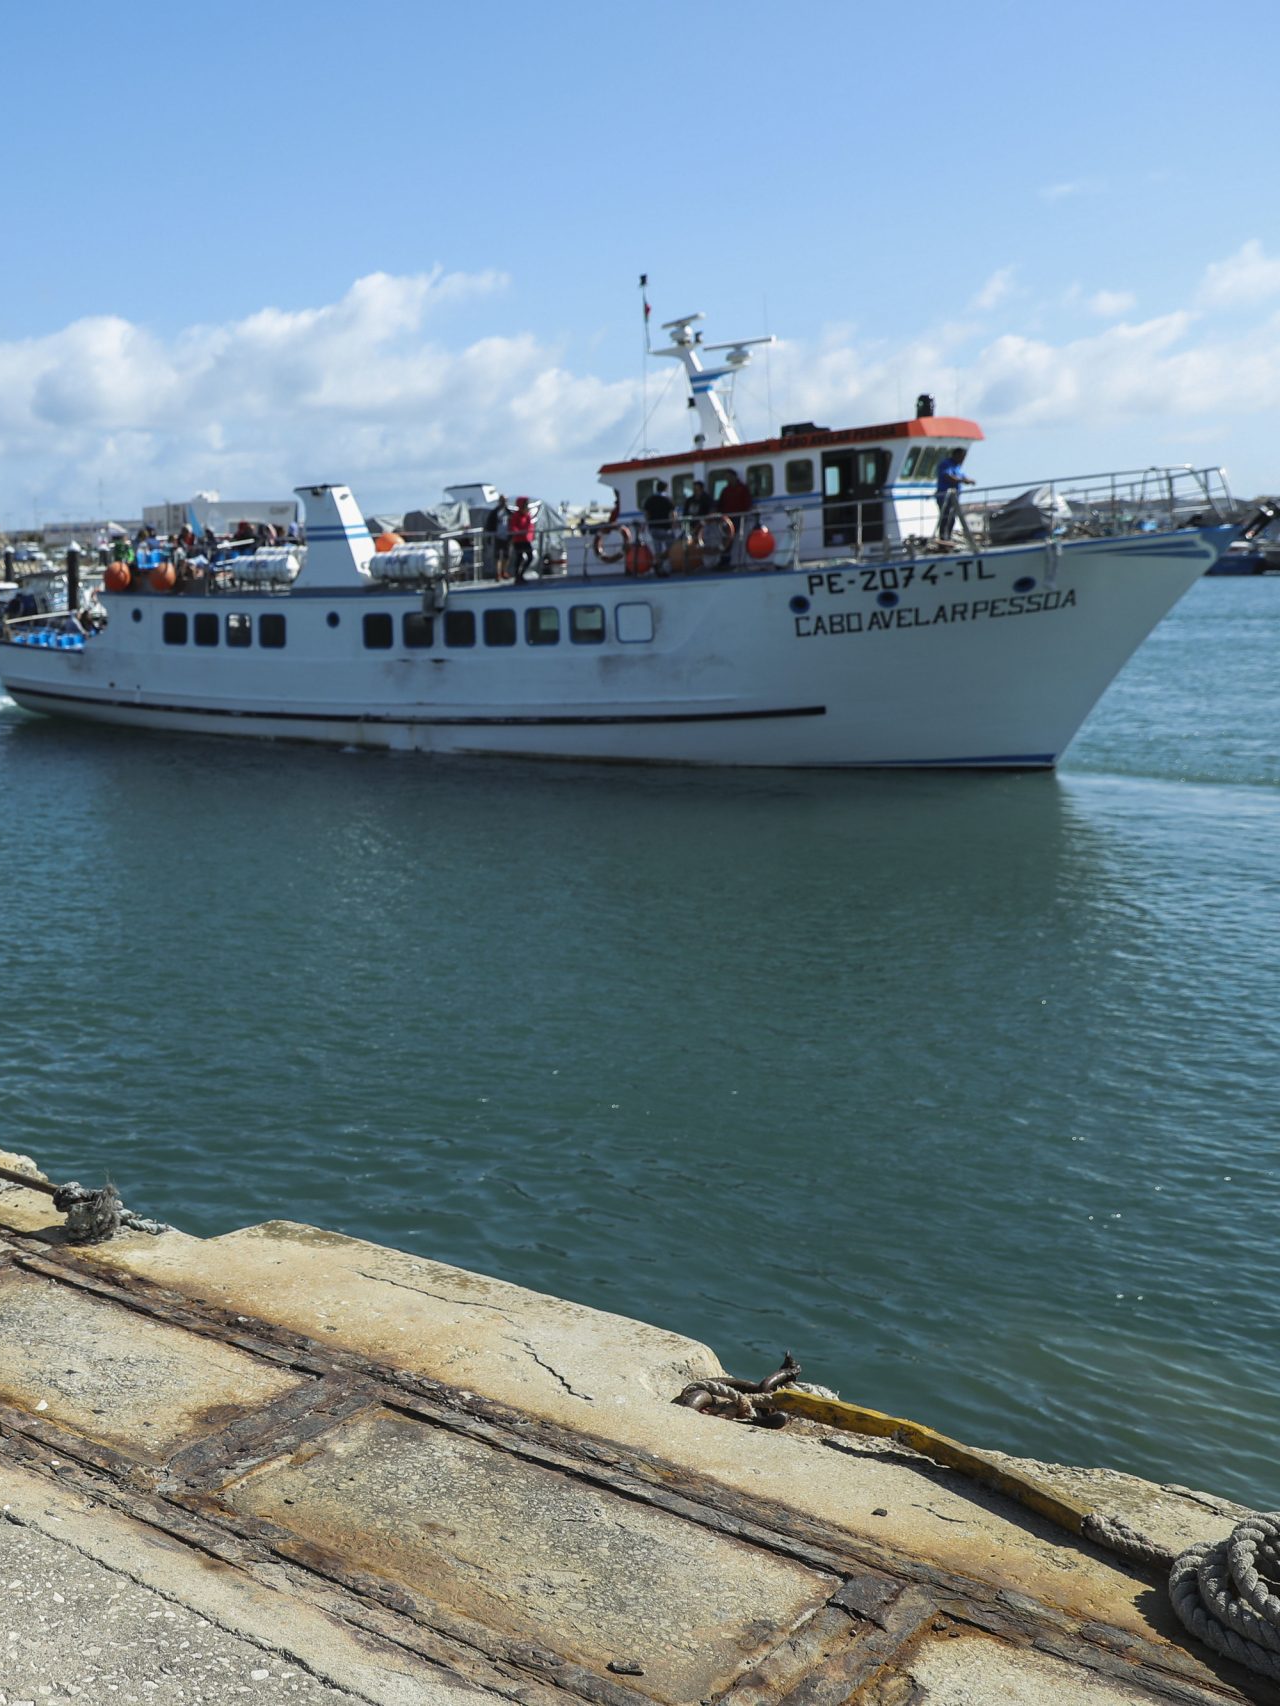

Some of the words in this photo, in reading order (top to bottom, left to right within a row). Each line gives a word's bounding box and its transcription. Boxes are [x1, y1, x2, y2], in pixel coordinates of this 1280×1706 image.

[807, 560, 996, 596] PE-2074-TL
[795, 612, 864, 638] CABO
[867, 601, 969, 631] AVELAR
[971, 589, 1077, 620] PESSOA
